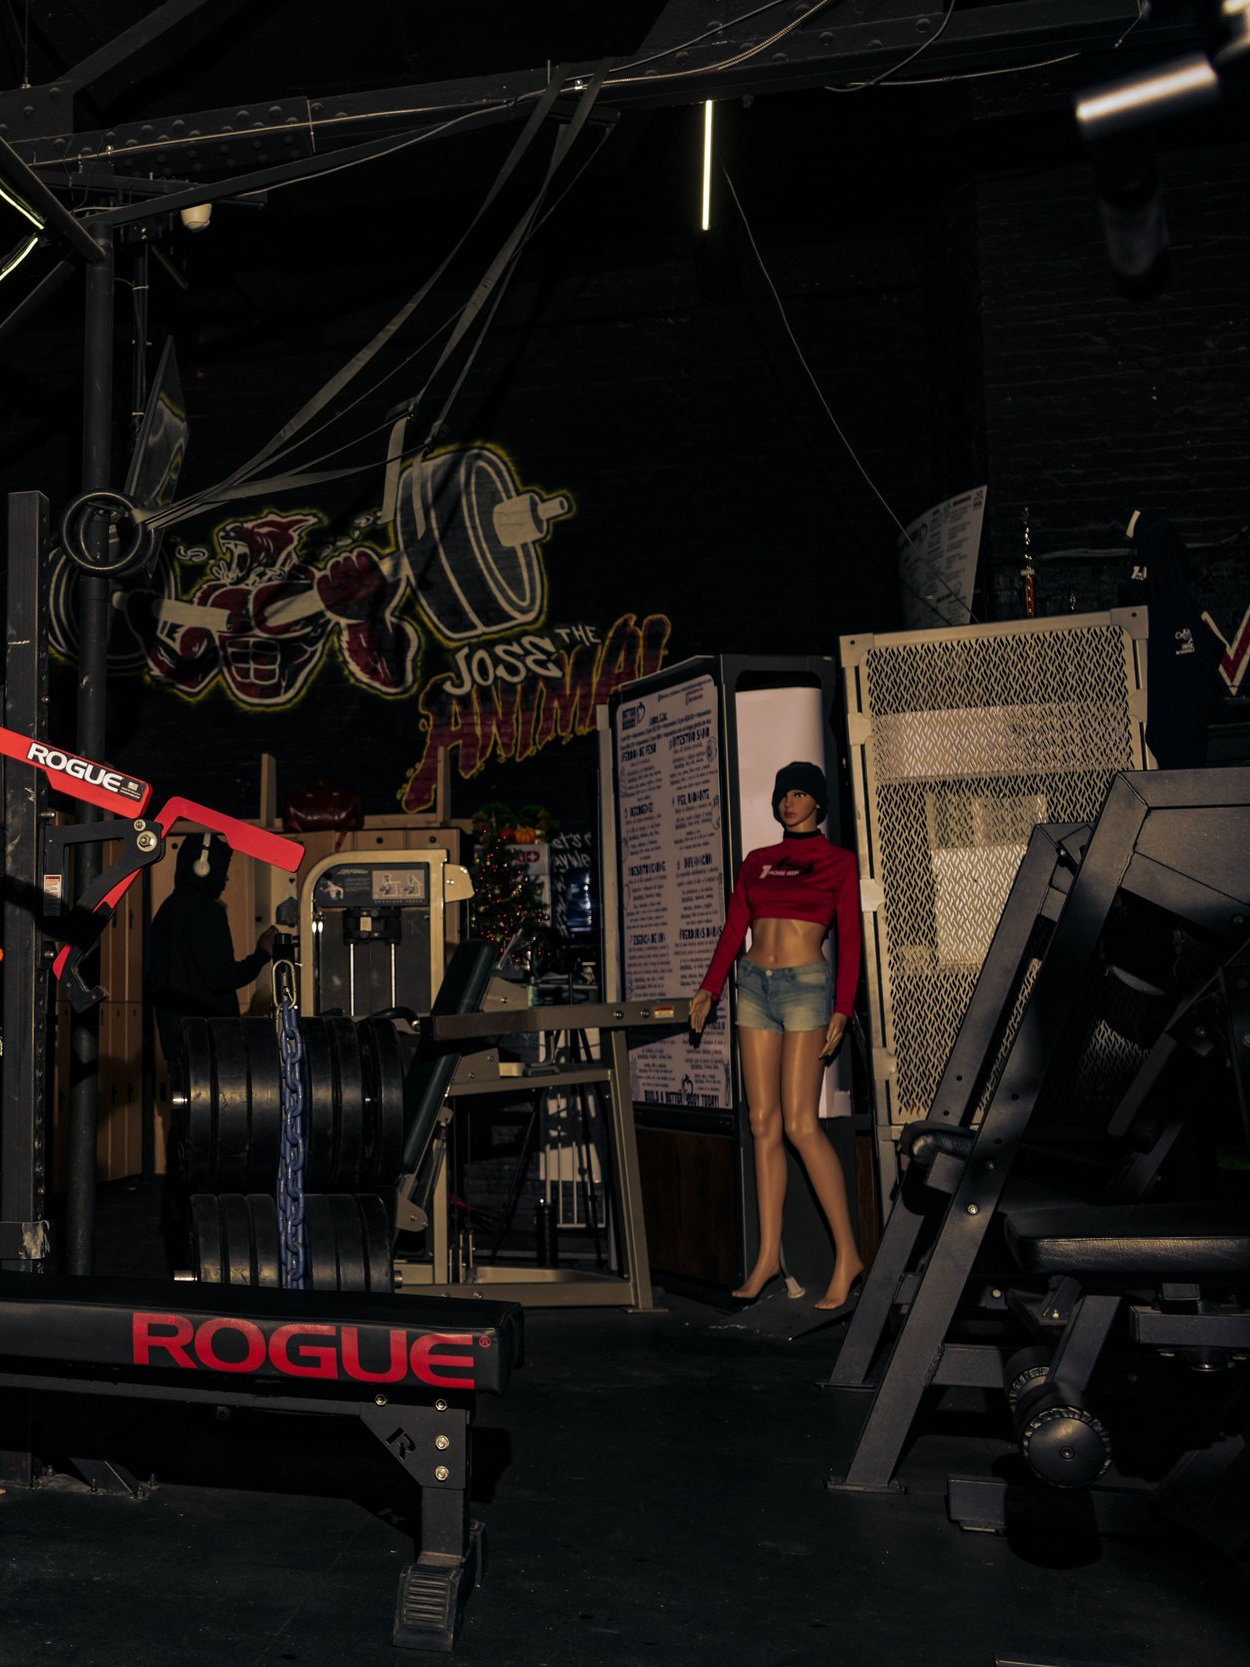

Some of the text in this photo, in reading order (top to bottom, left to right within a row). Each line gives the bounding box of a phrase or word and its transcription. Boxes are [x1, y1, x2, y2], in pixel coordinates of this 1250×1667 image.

[554, 624, 602, 647] THE
[443, 634, 563, 696] JOSE
[27, 742, 123, 793] ROGUE
[551, 831, 582, 850] et's
